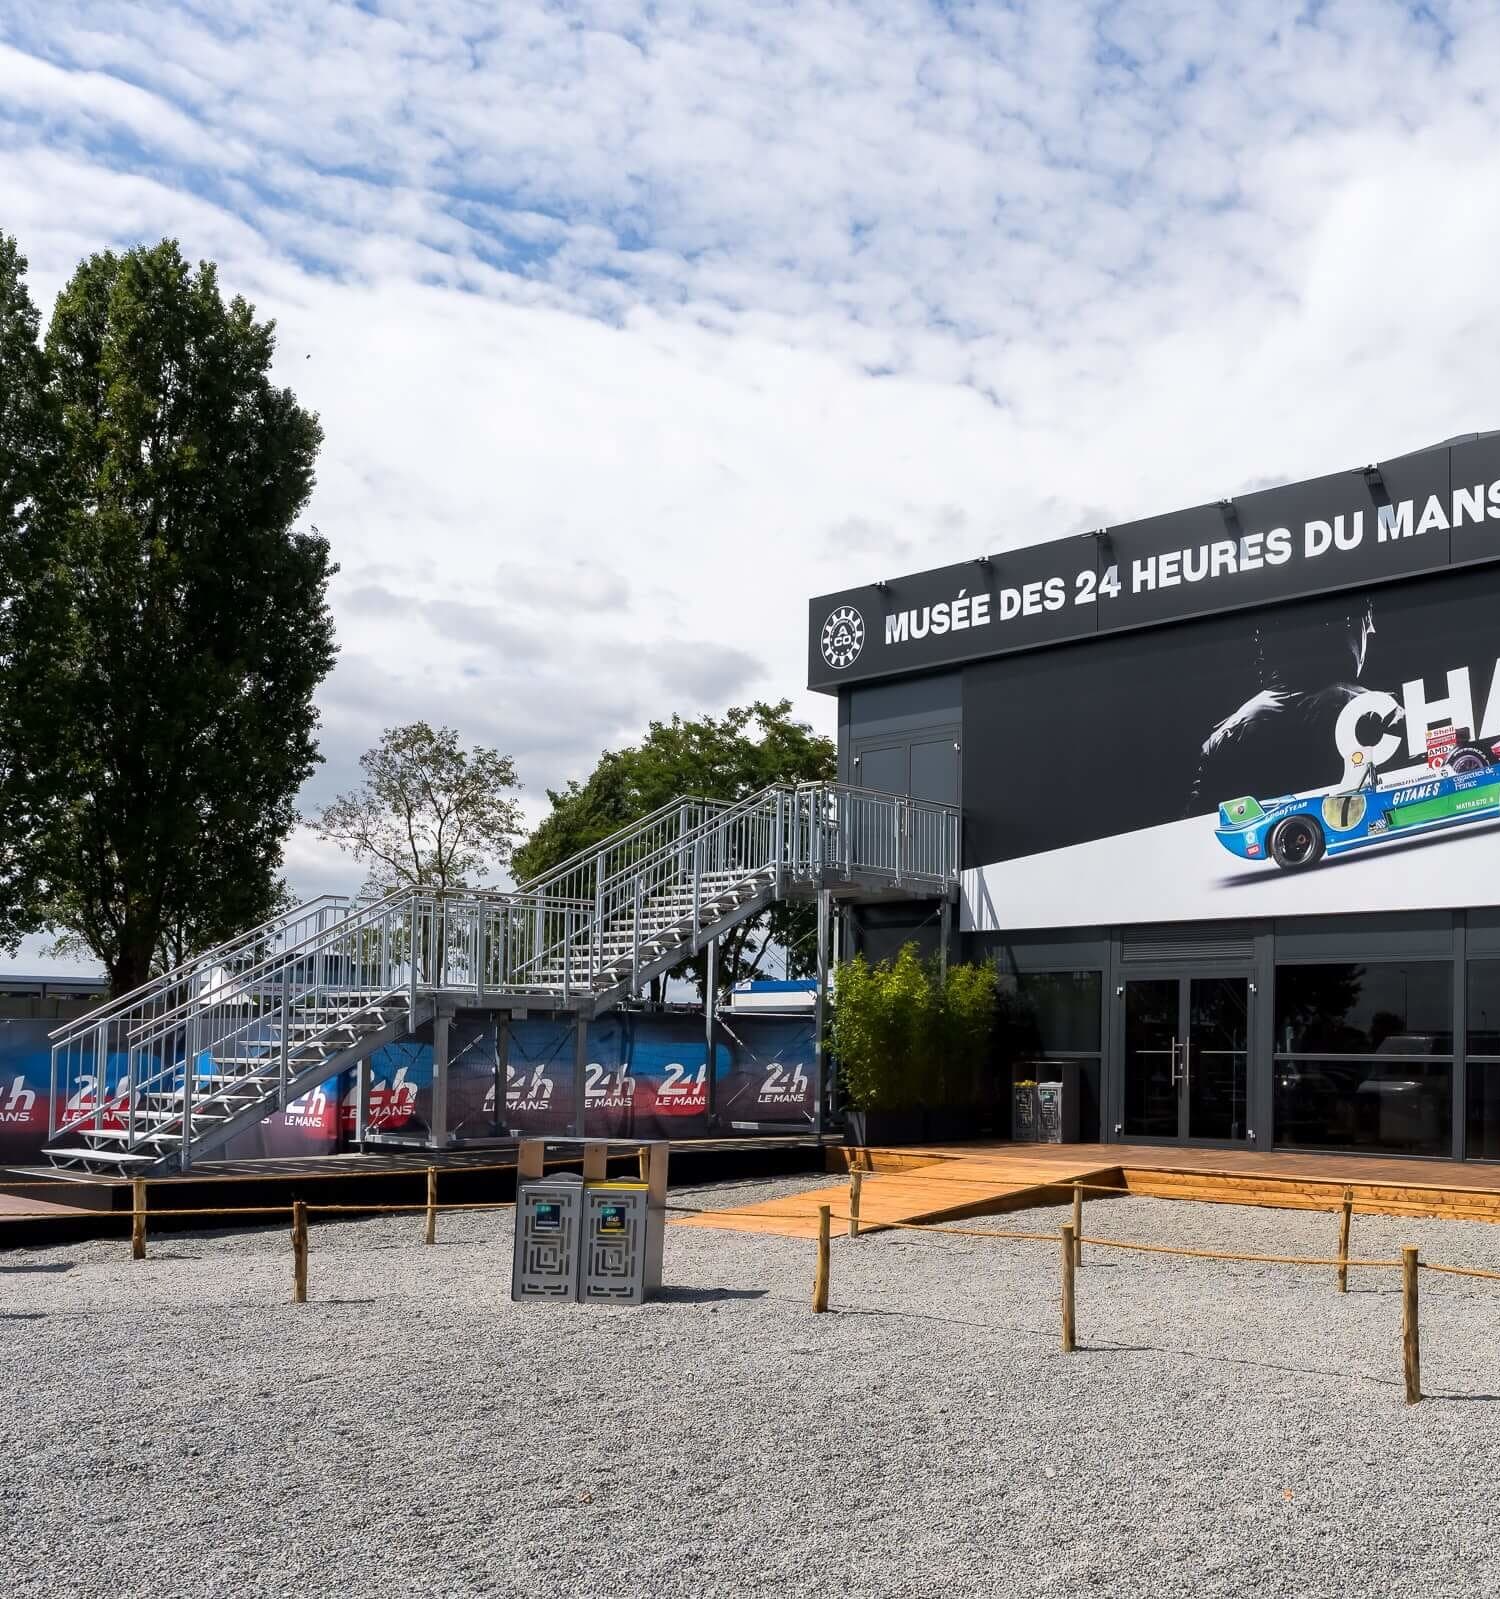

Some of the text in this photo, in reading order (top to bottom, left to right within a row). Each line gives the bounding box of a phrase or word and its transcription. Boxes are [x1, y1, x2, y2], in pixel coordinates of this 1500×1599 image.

[886, 589, 991, 645] MUSÉE
[1000, 578, 1066, 621] DES
[1075, 564, 1122, 606] 24
[1133, 528, 1293, 594] HEURES
[1305, 511, 1364, 559] DU
[1433, 726, 1455, 737] Shell
[1393, 782, 1441, 805] GITANES
[585, 1063, 636, 1097] 24h
[759, 1062, 808, 1094] 24h
[594, 1097, 633, 1108] MANS
[655, 1096, 706, 1106] LE MANS
[757, 1093, 804, 1103] LE MANS
[369, 1105, 412, 1117] MANS
[506, 1100, 549, 1111] MANS
[284, 1115, 294, 1126] LE
[294, 1116, 322, 1127] MANS
